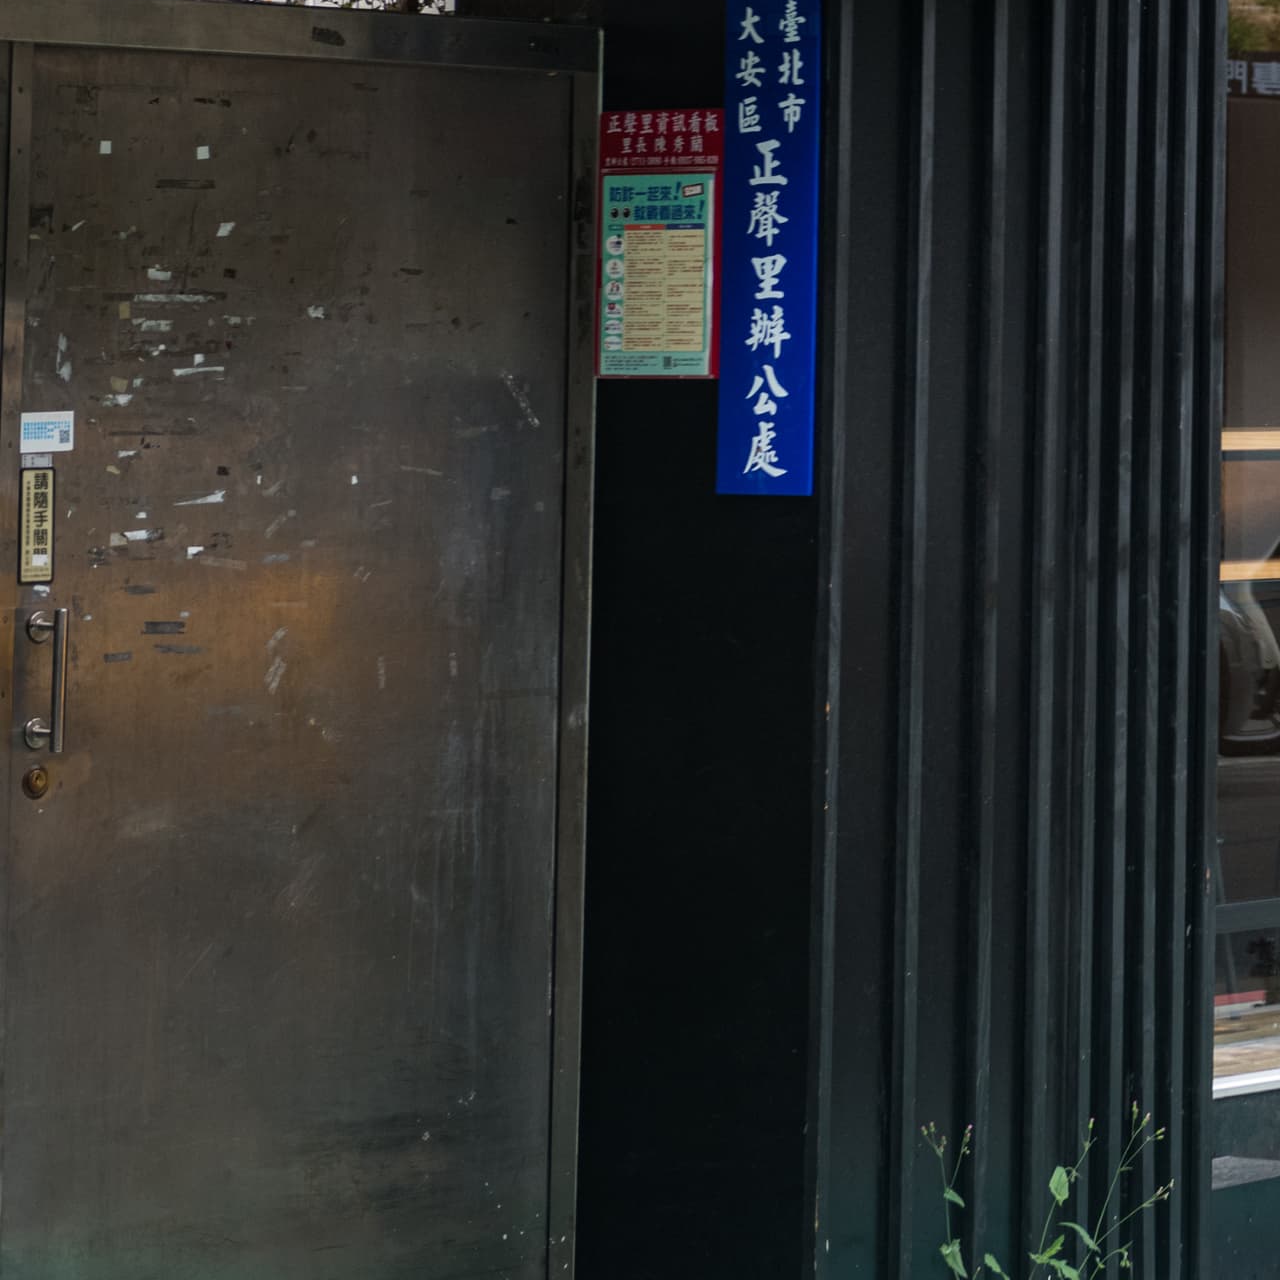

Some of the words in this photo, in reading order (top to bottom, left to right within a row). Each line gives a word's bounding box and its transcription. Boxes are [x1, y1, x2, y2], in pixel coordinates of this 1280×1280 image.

[607, 112, 718, 134] 正聲里資訊看板
[735, 6, 767, 134] 大安區
[777, 0, 806, 133] 臺北市
[743, 138, 791, 477] 正聲里辦公處
